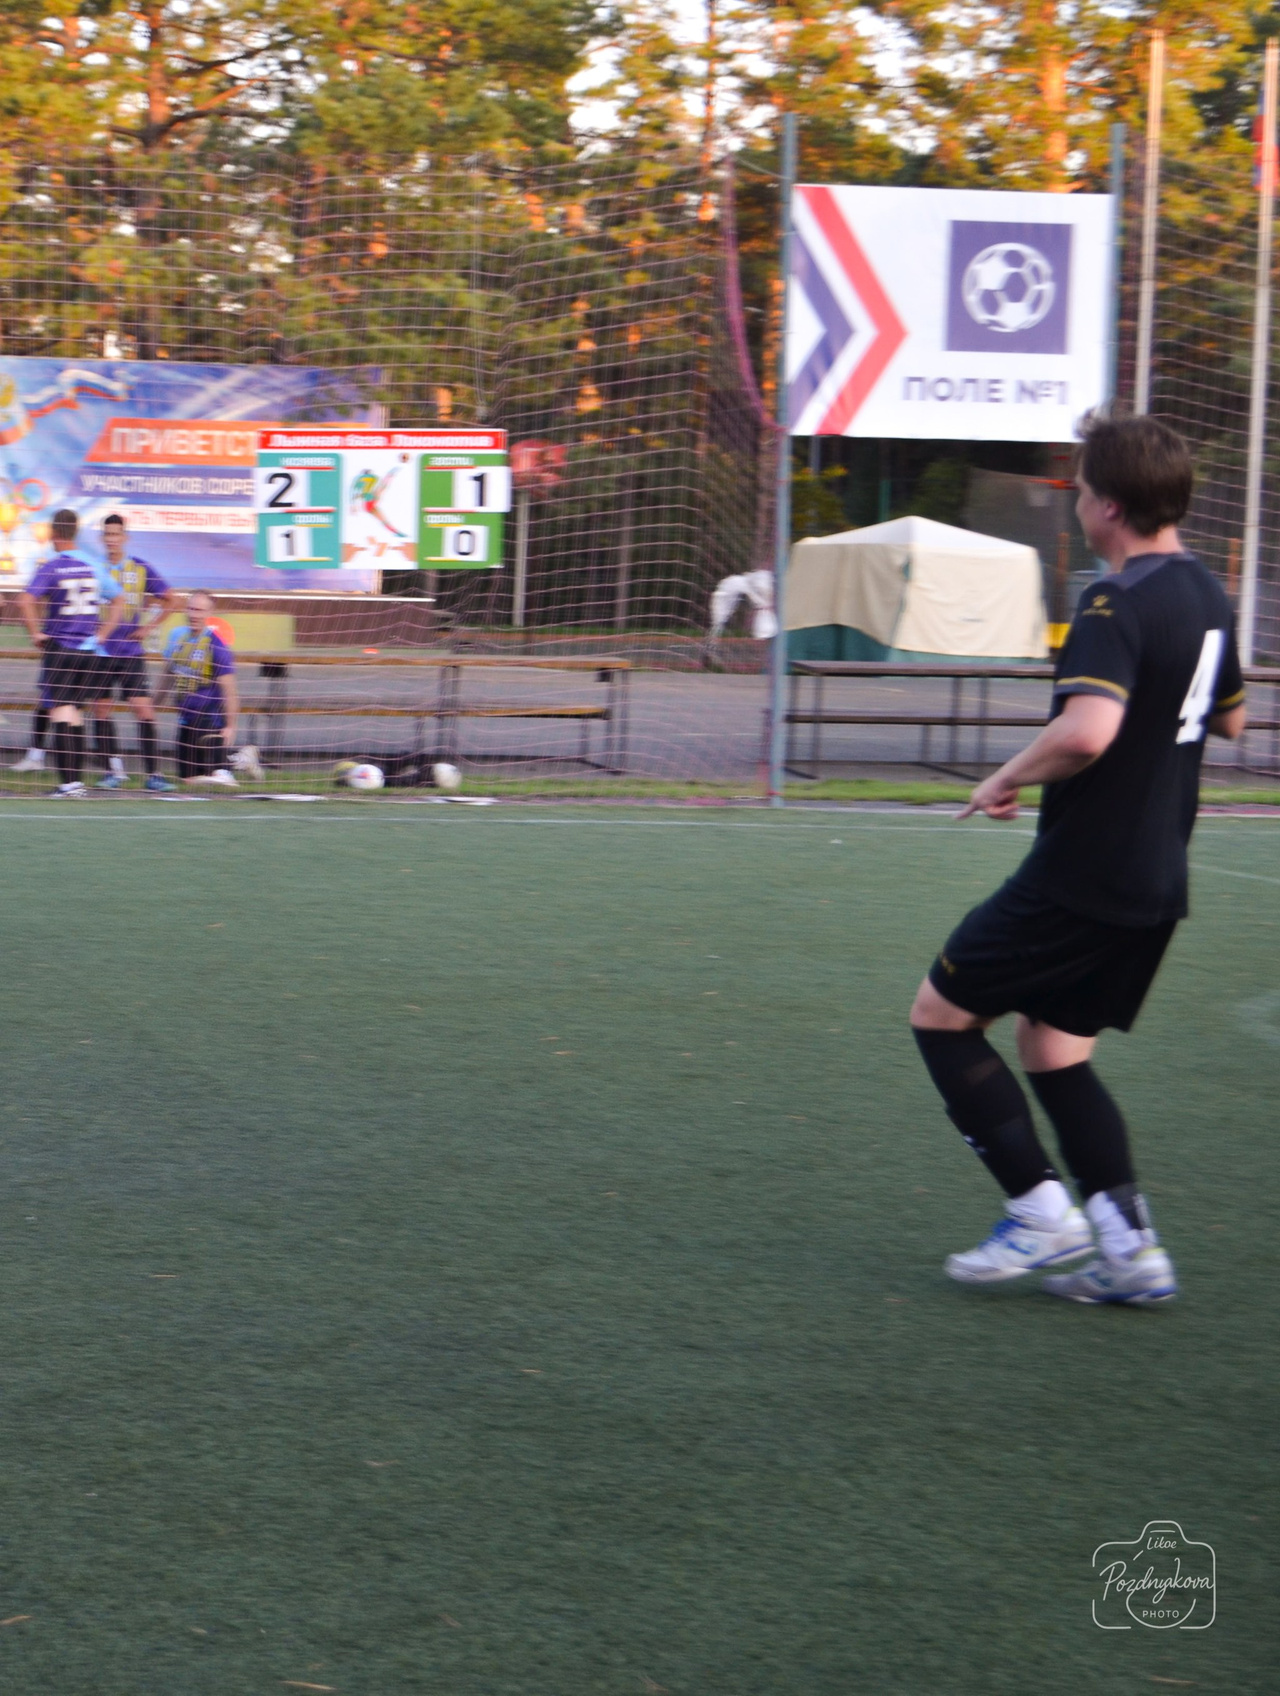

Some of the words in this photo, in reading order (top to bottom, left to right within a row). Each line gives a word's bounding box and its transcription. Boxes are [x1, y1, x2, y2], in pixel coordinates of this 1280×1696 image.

[902, 376, 1004, 403] ПОЛЕ
[1014, 379, 1069, 405] №1
[80, 474, 205, 495] УЧАСТНИКОВ
[207, 477, 257, 496] СОРЕ
[266, 472, 296, 508] 2
[470, 472, 487, 507] 1
[281, 530, 297, 556] 1
[453, 529, 476, 556] 0
[1176, 629, 1224, 744] 4
